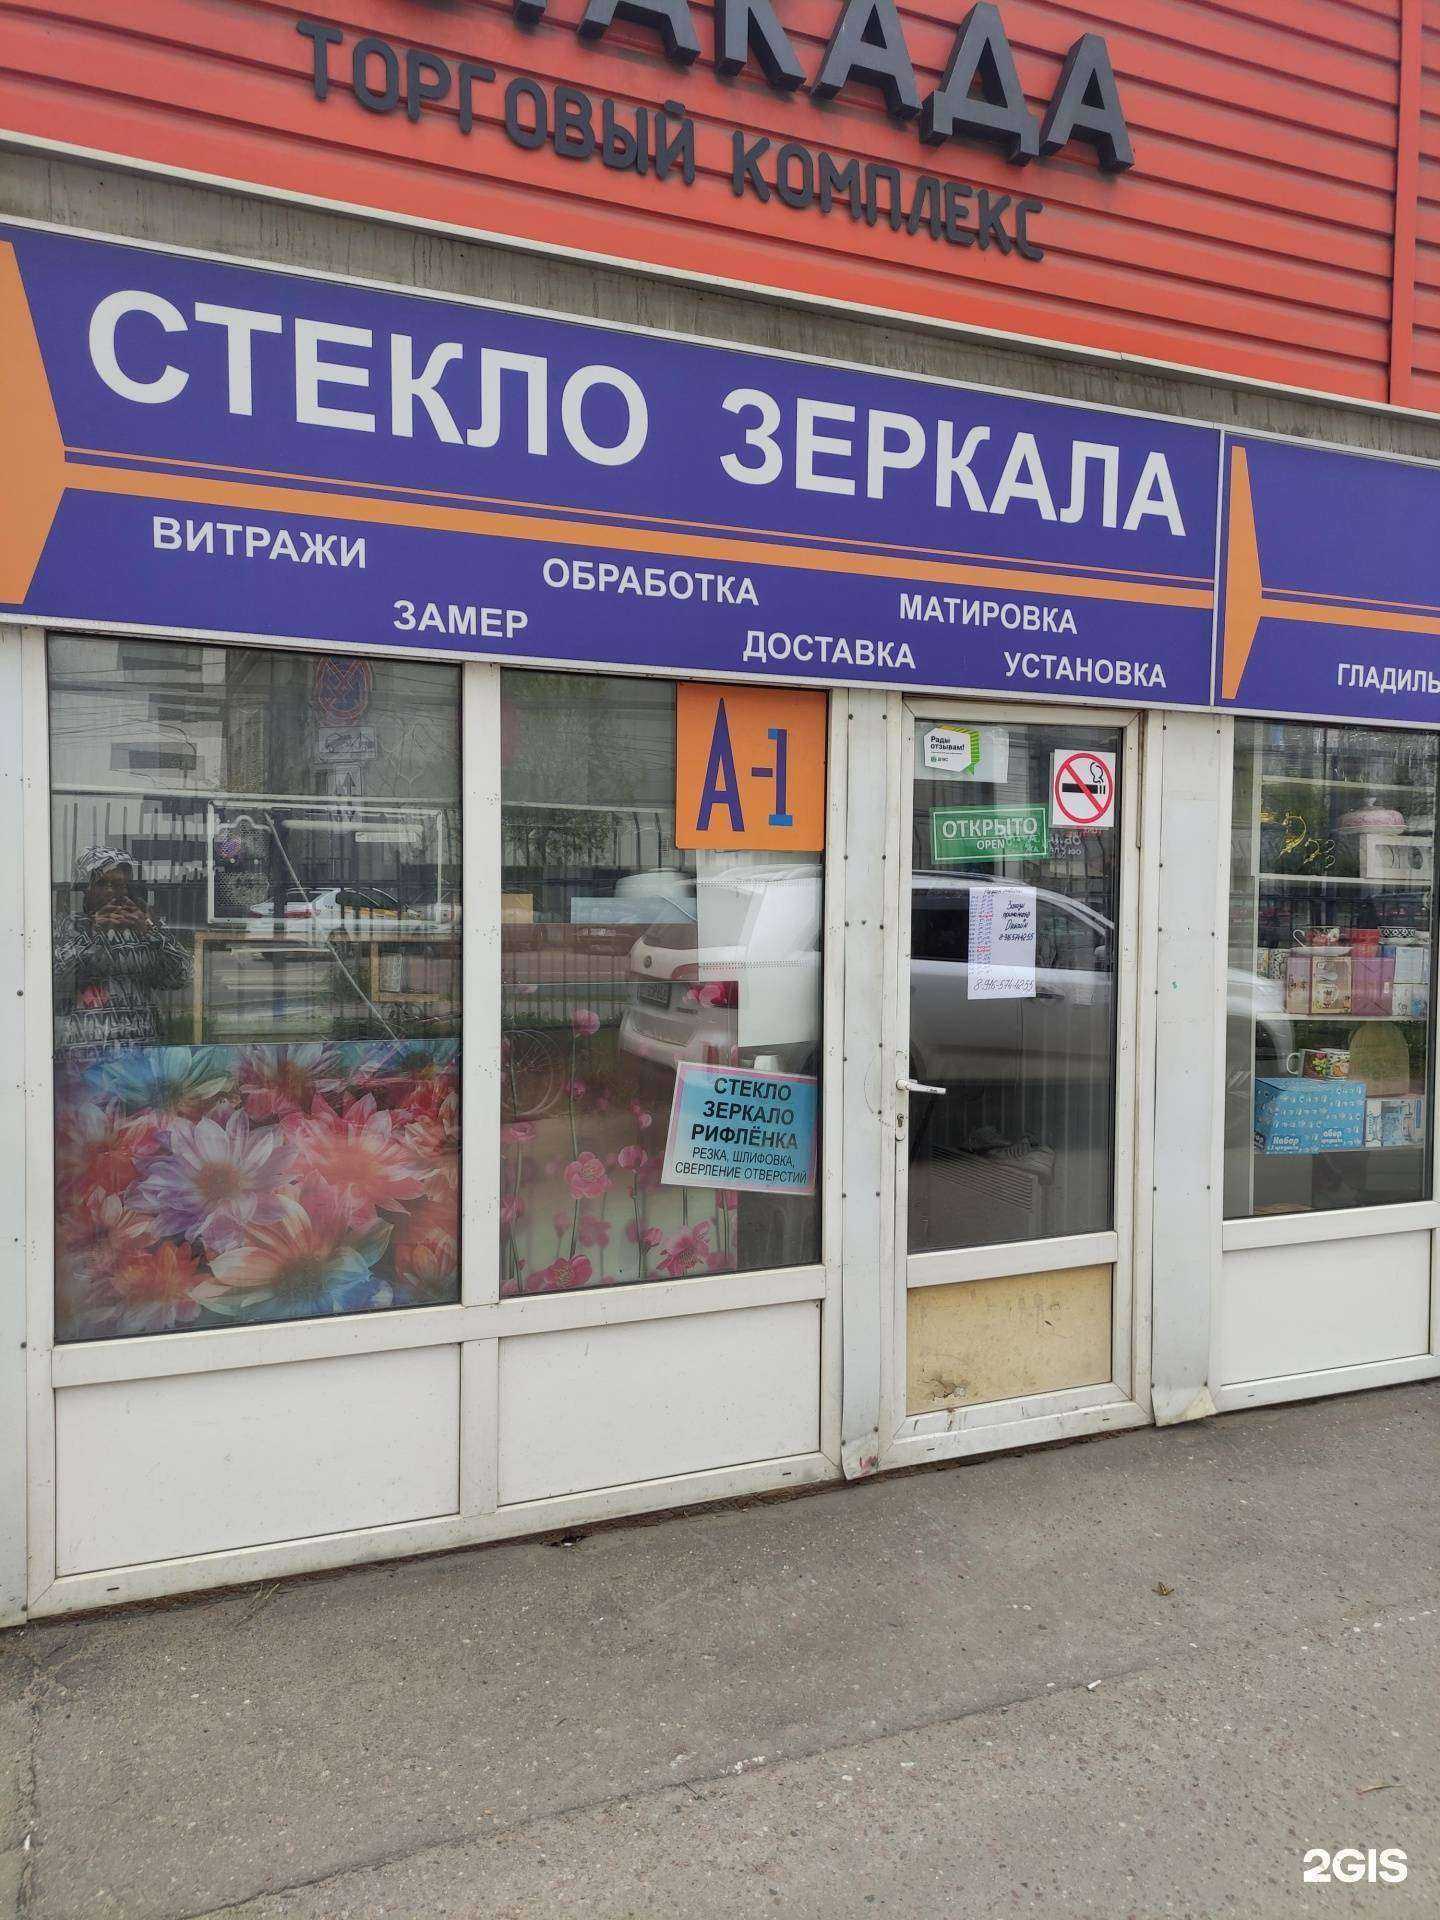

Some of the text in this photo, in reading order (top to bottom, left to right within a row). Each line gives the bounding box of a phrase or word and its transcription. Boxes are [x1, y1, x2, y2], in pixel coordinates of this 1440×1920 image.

[513, 0, 1135, 172] КАДА
[297, 20, 1045, 263] ТОРГОВЫЙ КОМПЛЕКС
[88, 289, 1187, 537] СТЕКЛО ЗЕРКАЛА
[153, 516, 366, 569] ВИТРАЖИ
[542, 557, 760, 606] ОБРАБОТКА
[392, 600, 529, 639] ЗАМЕР
[899, 592, 1078, 635] МАТИРОВКА
[742, 631, 916, 670] ДОСТАВКА
[1003, 652, 1167, 689] УСТАНОВКА
[1337, 663, 1440, 694] ГЛАДИЛЬ
[930, 736, 950, 744] Рады
[930, 743, 965, 751] отзывам!
[695, 697, 793, 832] А-1
[942, 817, 1037, 838] ОТКРЫТО
[976, 838, 1005, 850] OPEN
[713, 1077, 792, 1101] СТЕКЛО
[703, 1100, 795, 1126] ЗЕРКАЛО
[691, 1123, 798, 1149] РИФЛЁНКА
[675, 1161, 807, 1184] СВЕРЛЕНИЕ ОТВЕРСТИЙ
[692, 1146, 795, 1168] РЕЗКА, ШЛИФОВКА,
